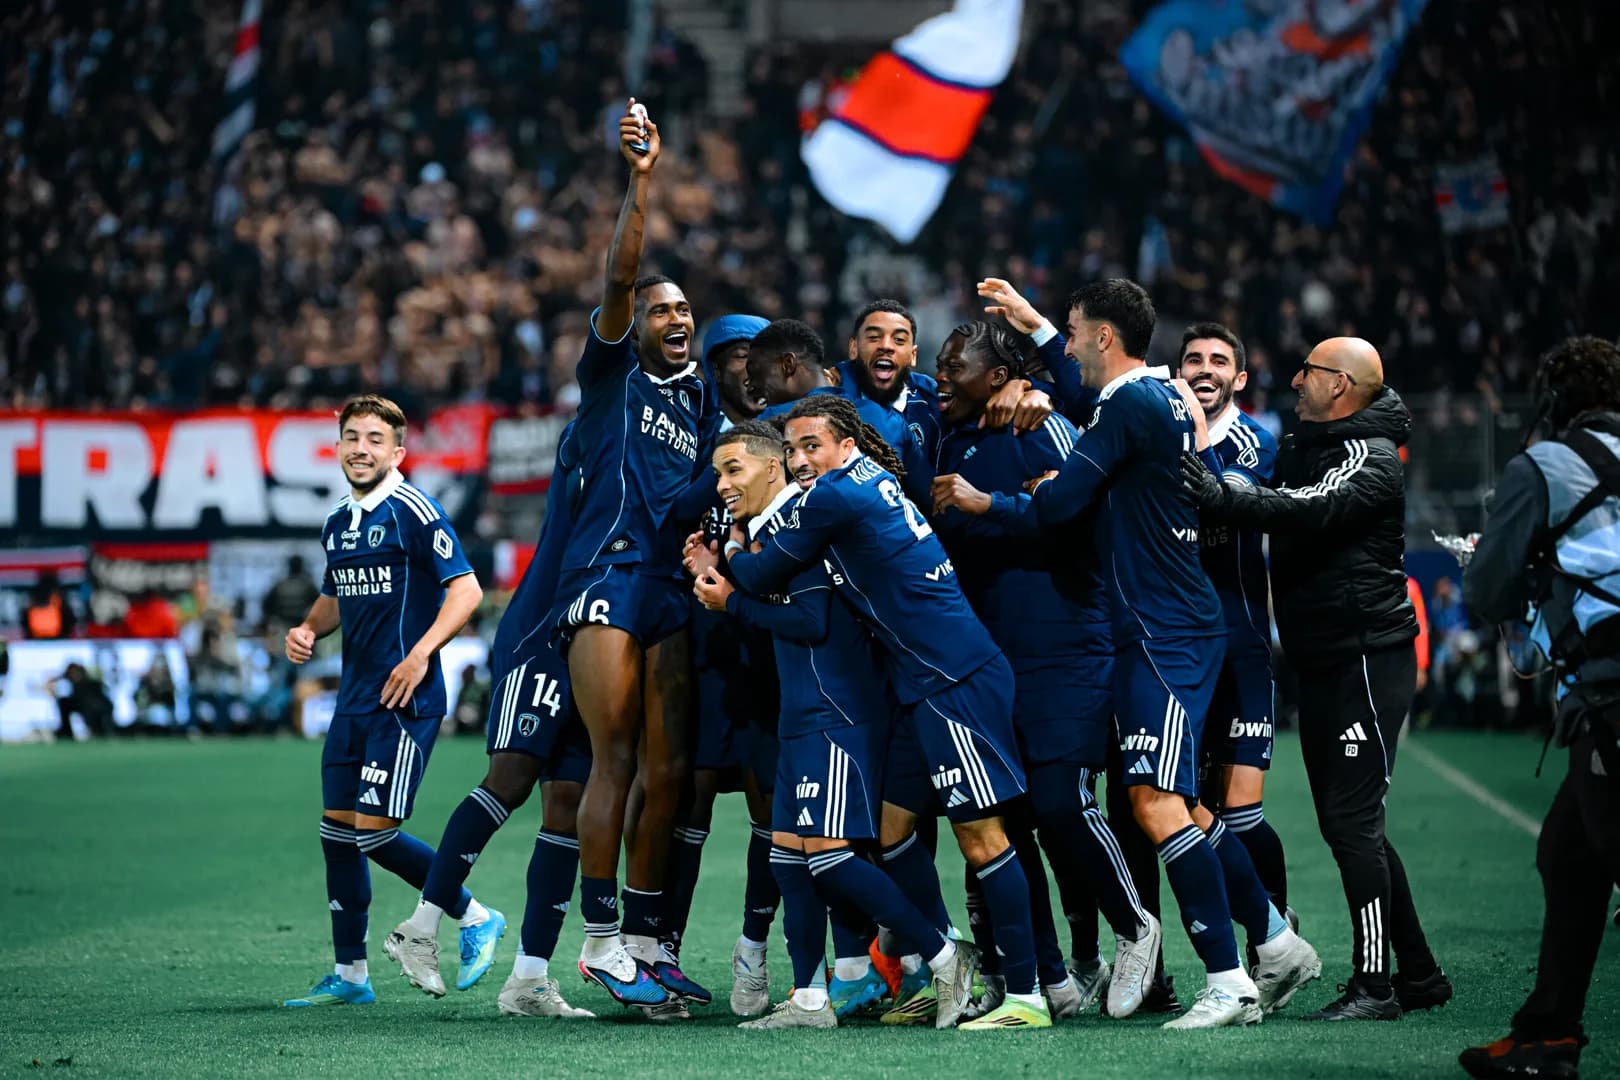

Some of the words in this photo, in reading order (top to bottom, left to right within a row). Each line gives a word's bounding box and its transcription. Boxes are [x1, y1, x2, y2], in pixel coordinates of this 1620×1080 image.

[341, 530, 361, 540] Google
[342, 541, 357, 550] Pixel
[531, 673, 561, 717] 14
[1229, 716, 1272, 738] bwin
